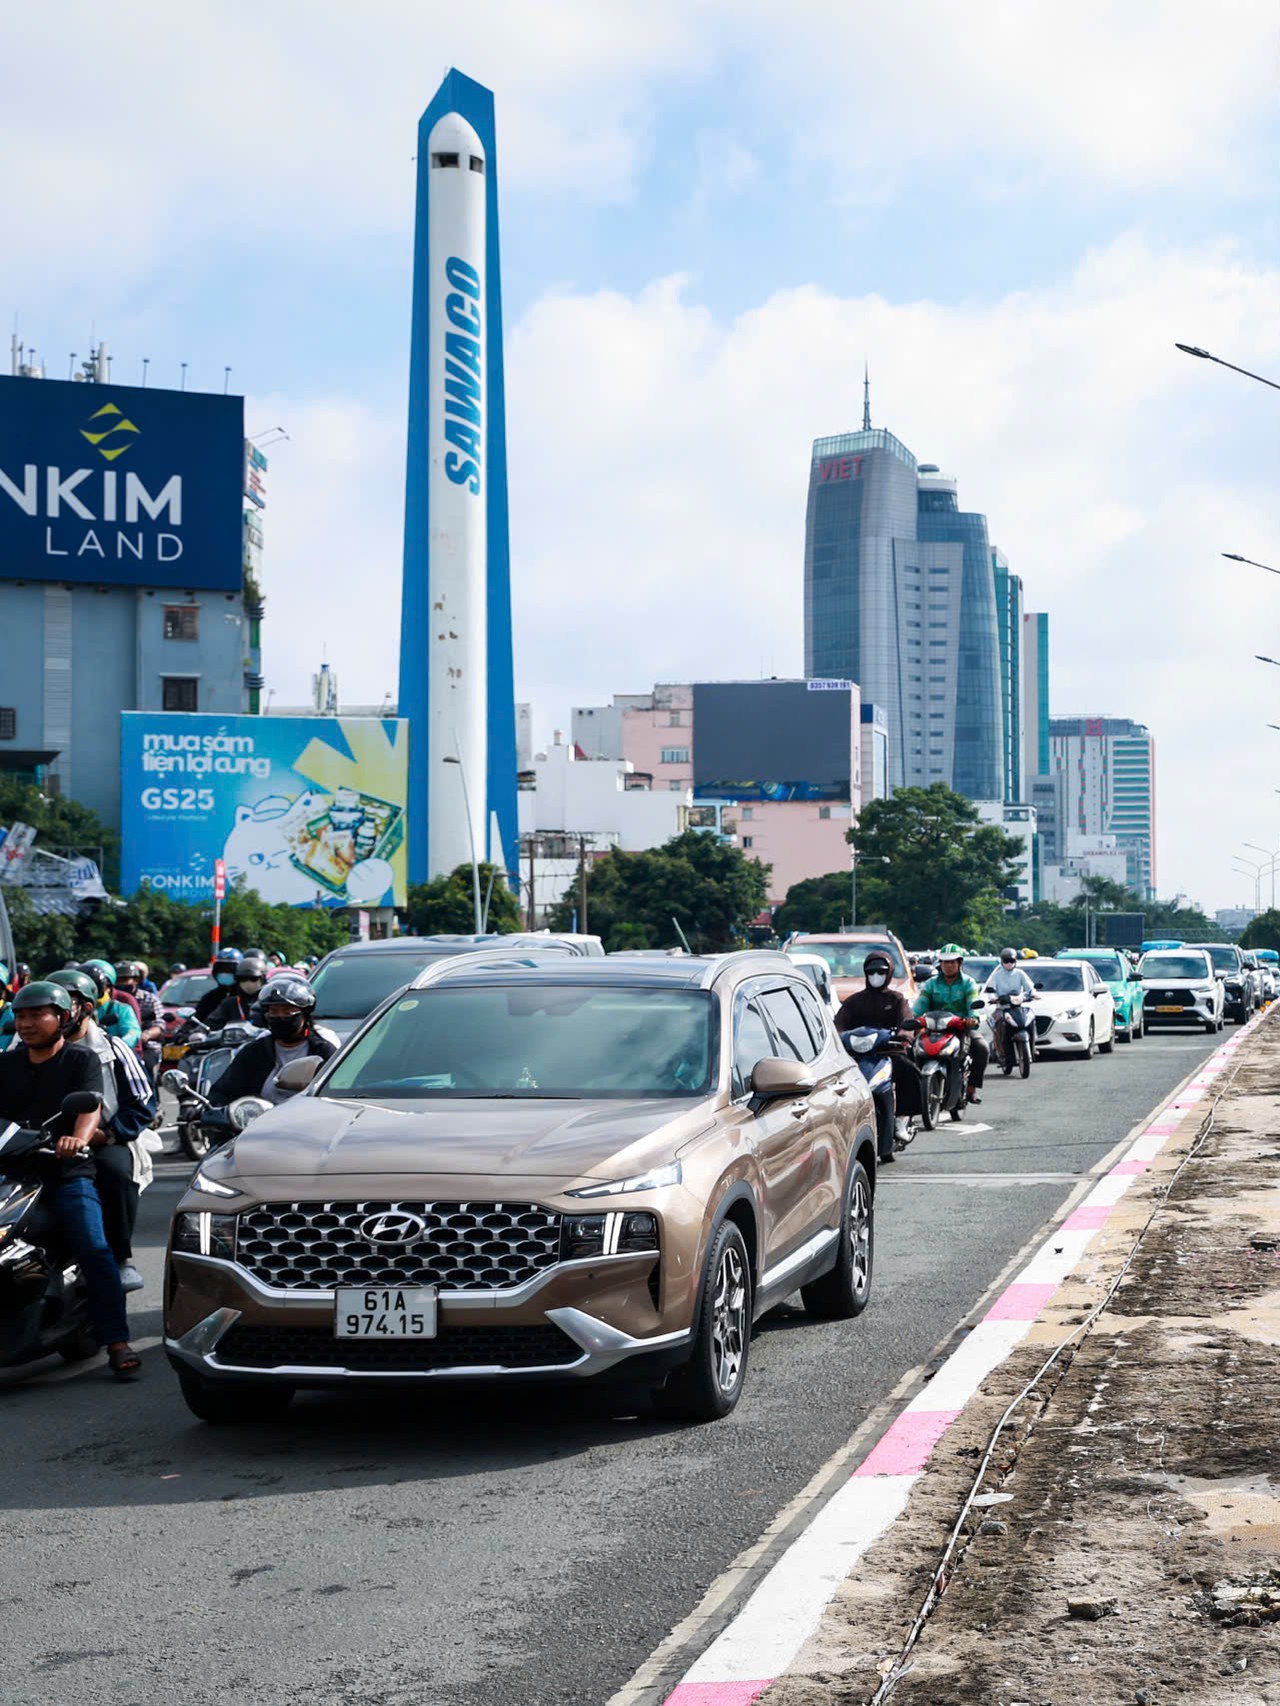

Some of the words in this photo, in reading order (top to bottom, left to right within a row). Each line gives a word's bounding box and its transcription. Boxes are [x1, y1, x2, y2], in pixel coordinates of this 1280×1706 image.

[445, 256, 481, 496] SAWACO
[46, 526, 183, 561] LAND
[143, 734, 200, 751] mua
[202, 725, 255, 753] sắm
[143, 750, 184, 779] tiện
[141, 787, 215, 810] GS25
[364, 1291, 406, 1311] 61A
[346, 1314, 424, 1335] 974.15
